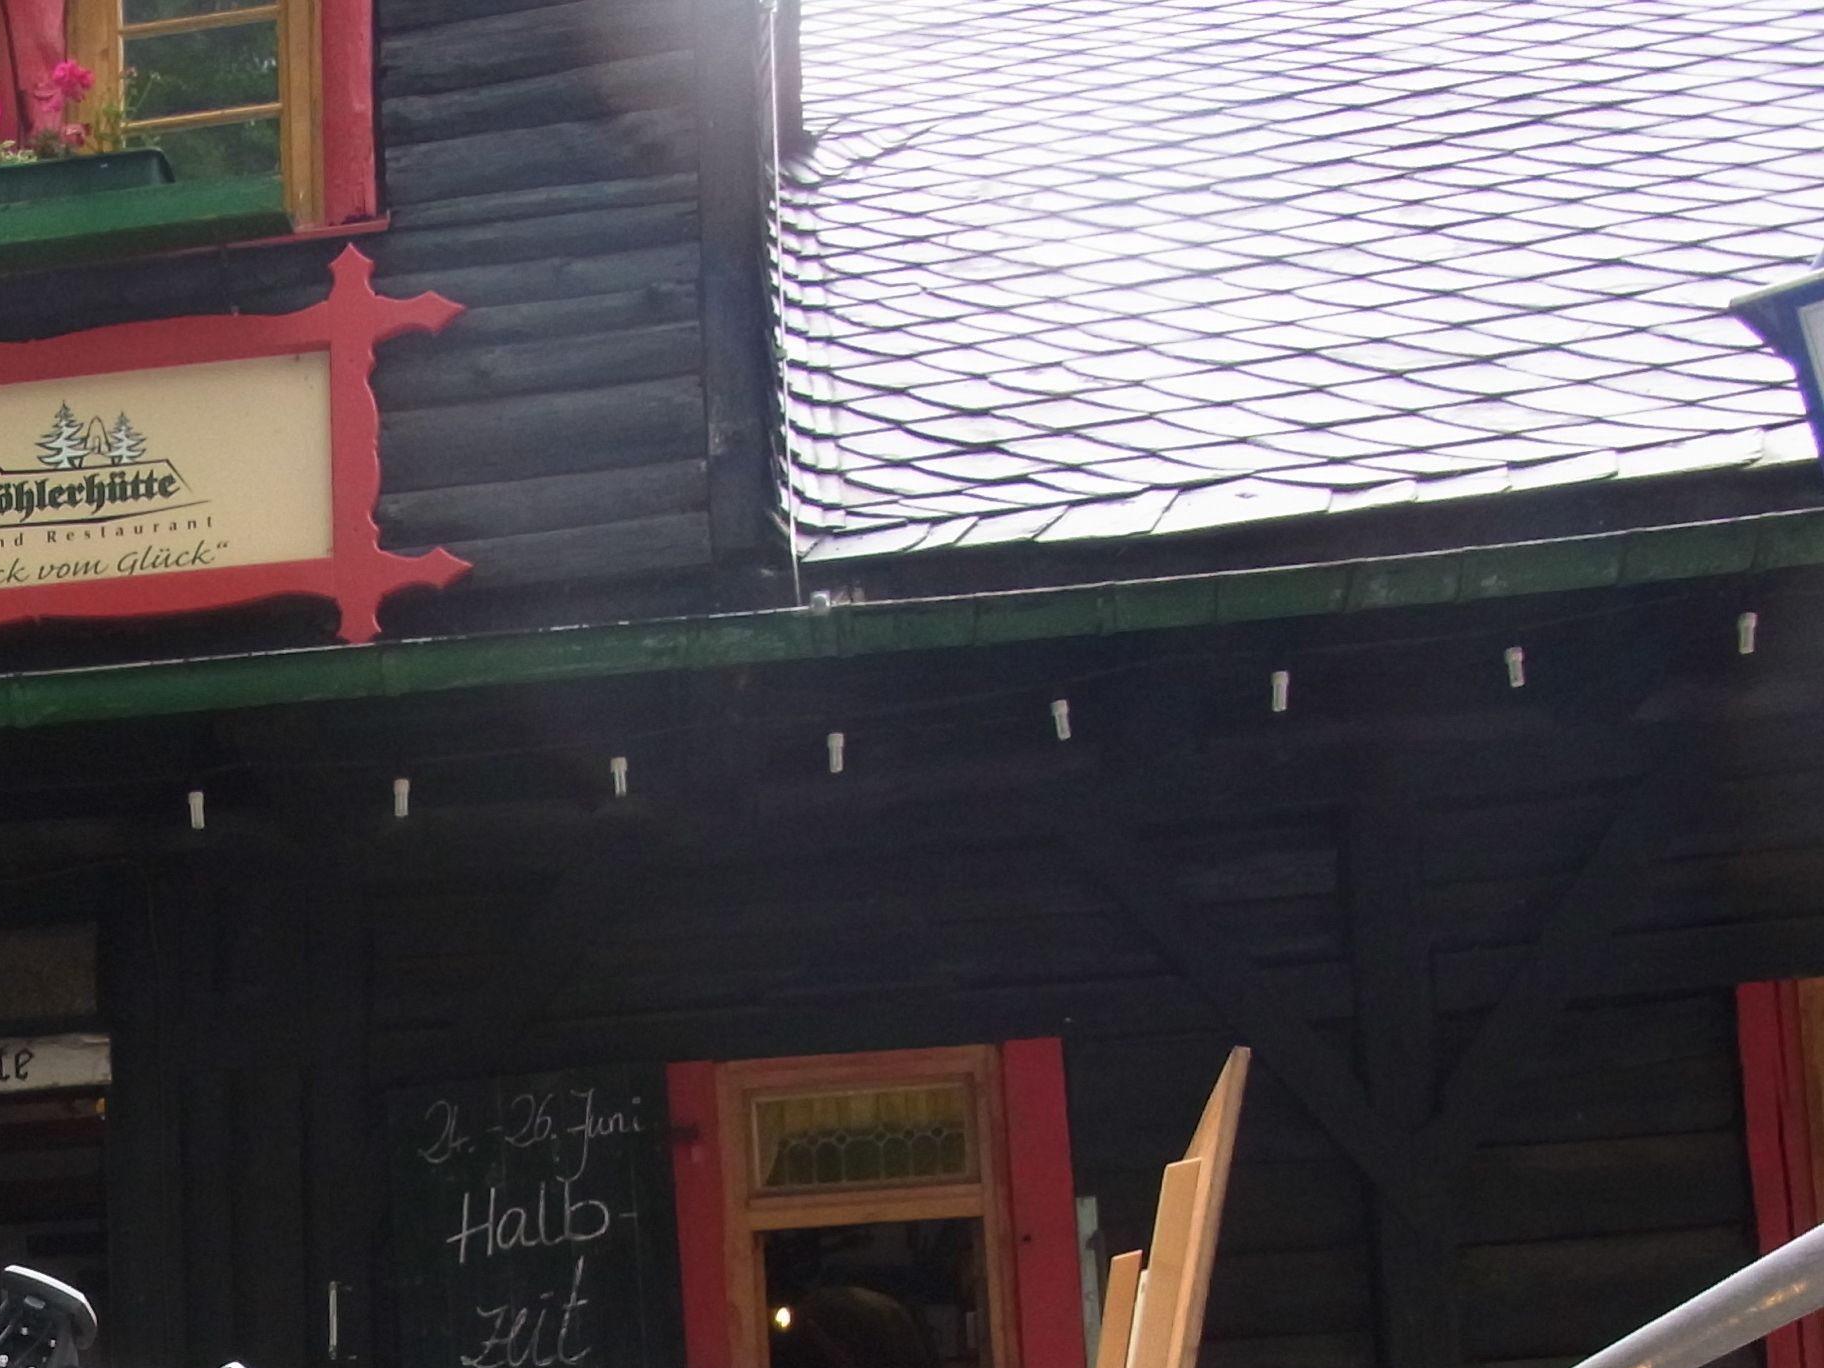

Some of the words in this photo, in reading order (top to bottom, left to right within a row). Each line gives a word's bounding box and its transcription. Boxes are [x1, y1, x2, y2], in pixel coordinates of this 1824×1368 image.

[46, 516, 214, 543] Restaurant
[37, 560, 109, 581] vom
[556, 1088, 641, 1182] Juni
